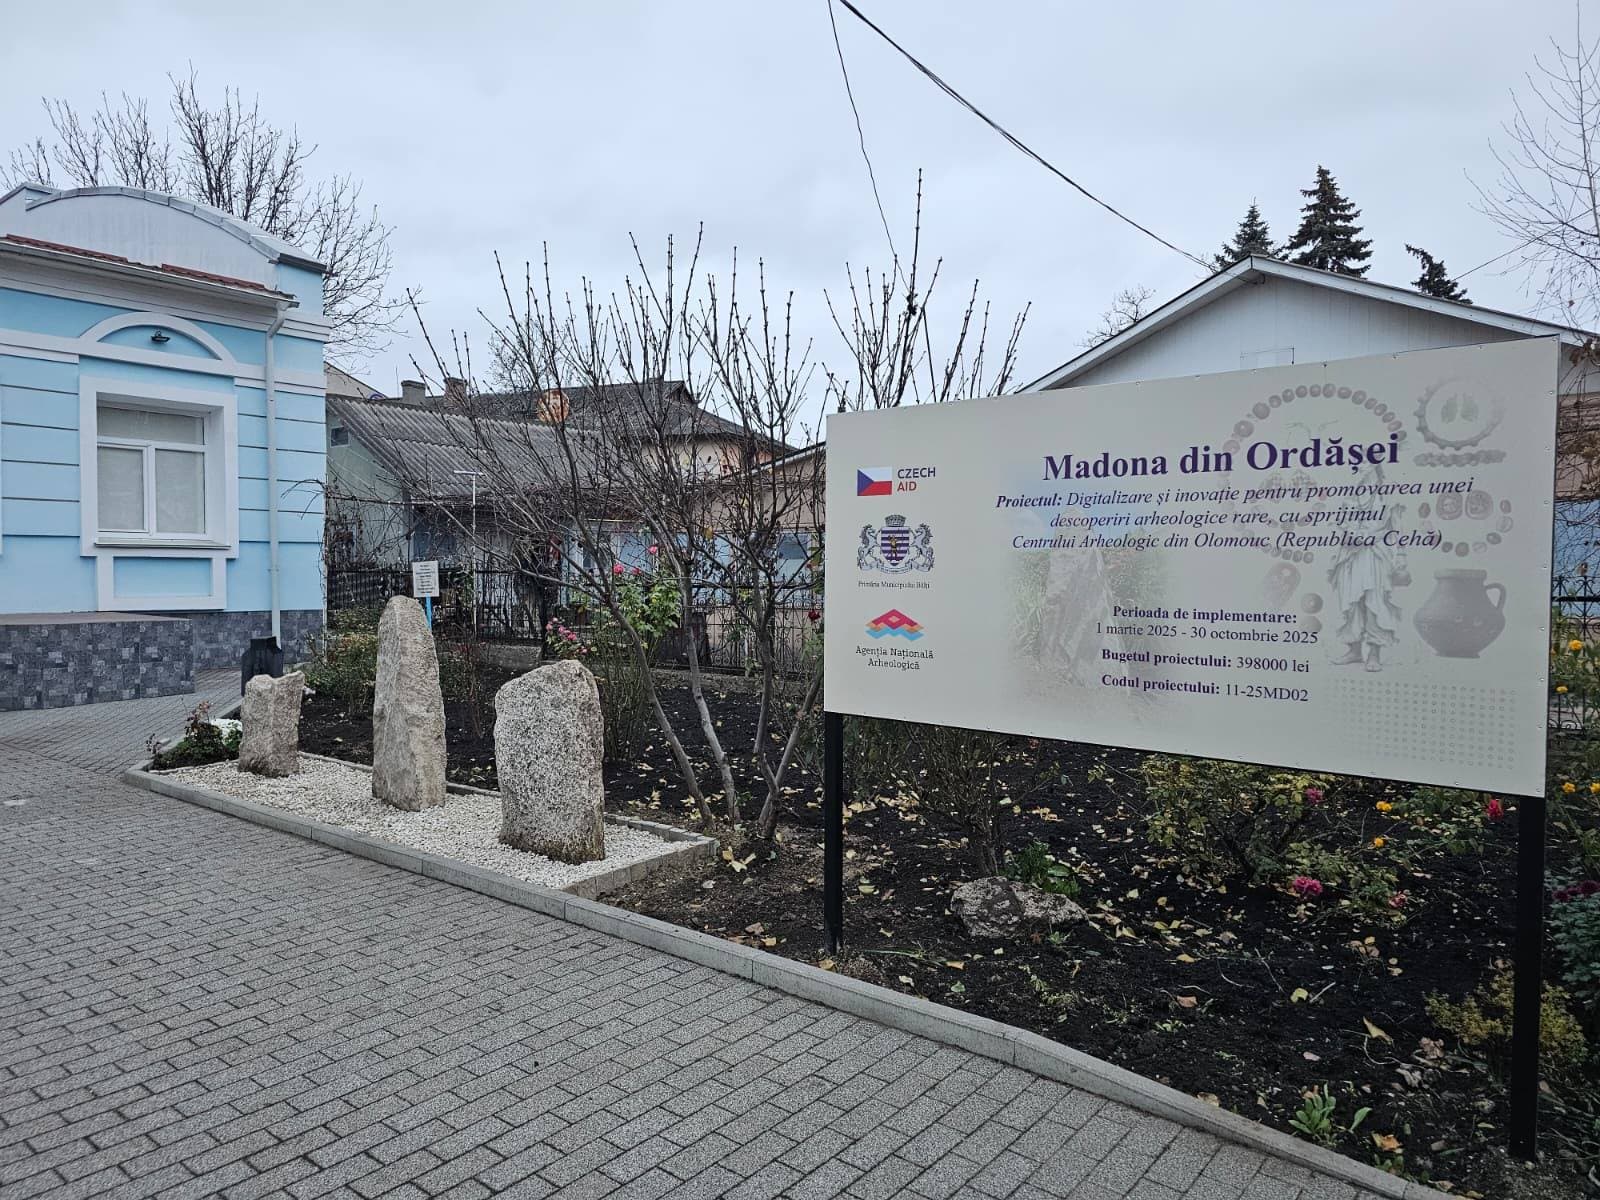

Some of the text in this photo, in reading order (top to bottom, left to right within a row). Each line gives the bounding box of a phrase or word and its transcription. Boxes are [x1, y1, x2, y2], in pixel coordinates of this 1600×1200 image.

[1043, 433, 1400, 481] Madona din Ordășei
[897, 467, 936, 479] CZECH
[897, 481, 917, 492] AID
[996, 477, 1475, 508] Proiectul: Digitalizare și inovație pentru promovarea unei
[1050, 505, 1386, 530] descoperiri arheologice rare, cu sprijinul
[1012, 530, 1443, 551] Centrului Arheologic din Olomouc (Republica Cehă)
[1113, 605, 1297, 624] Perioada de implementare:
[1096, 622, 1102, 634] 1
[1106, 624, 1144, 636] martie
[1147, 624, 1177, 638] 2025
[1190, 626, 1207, 639] 30
[1210, 627, 1279, 643] octombrie
[1283, 630, 1318, 644] 2025
[868, 658, 920, 671] Arheologică
[1102, 648, 1310, 673] Bugetul proiectului: 398000 lei
[1102, 674, 1309, 702] Codul proiectului: 11-25MD02
